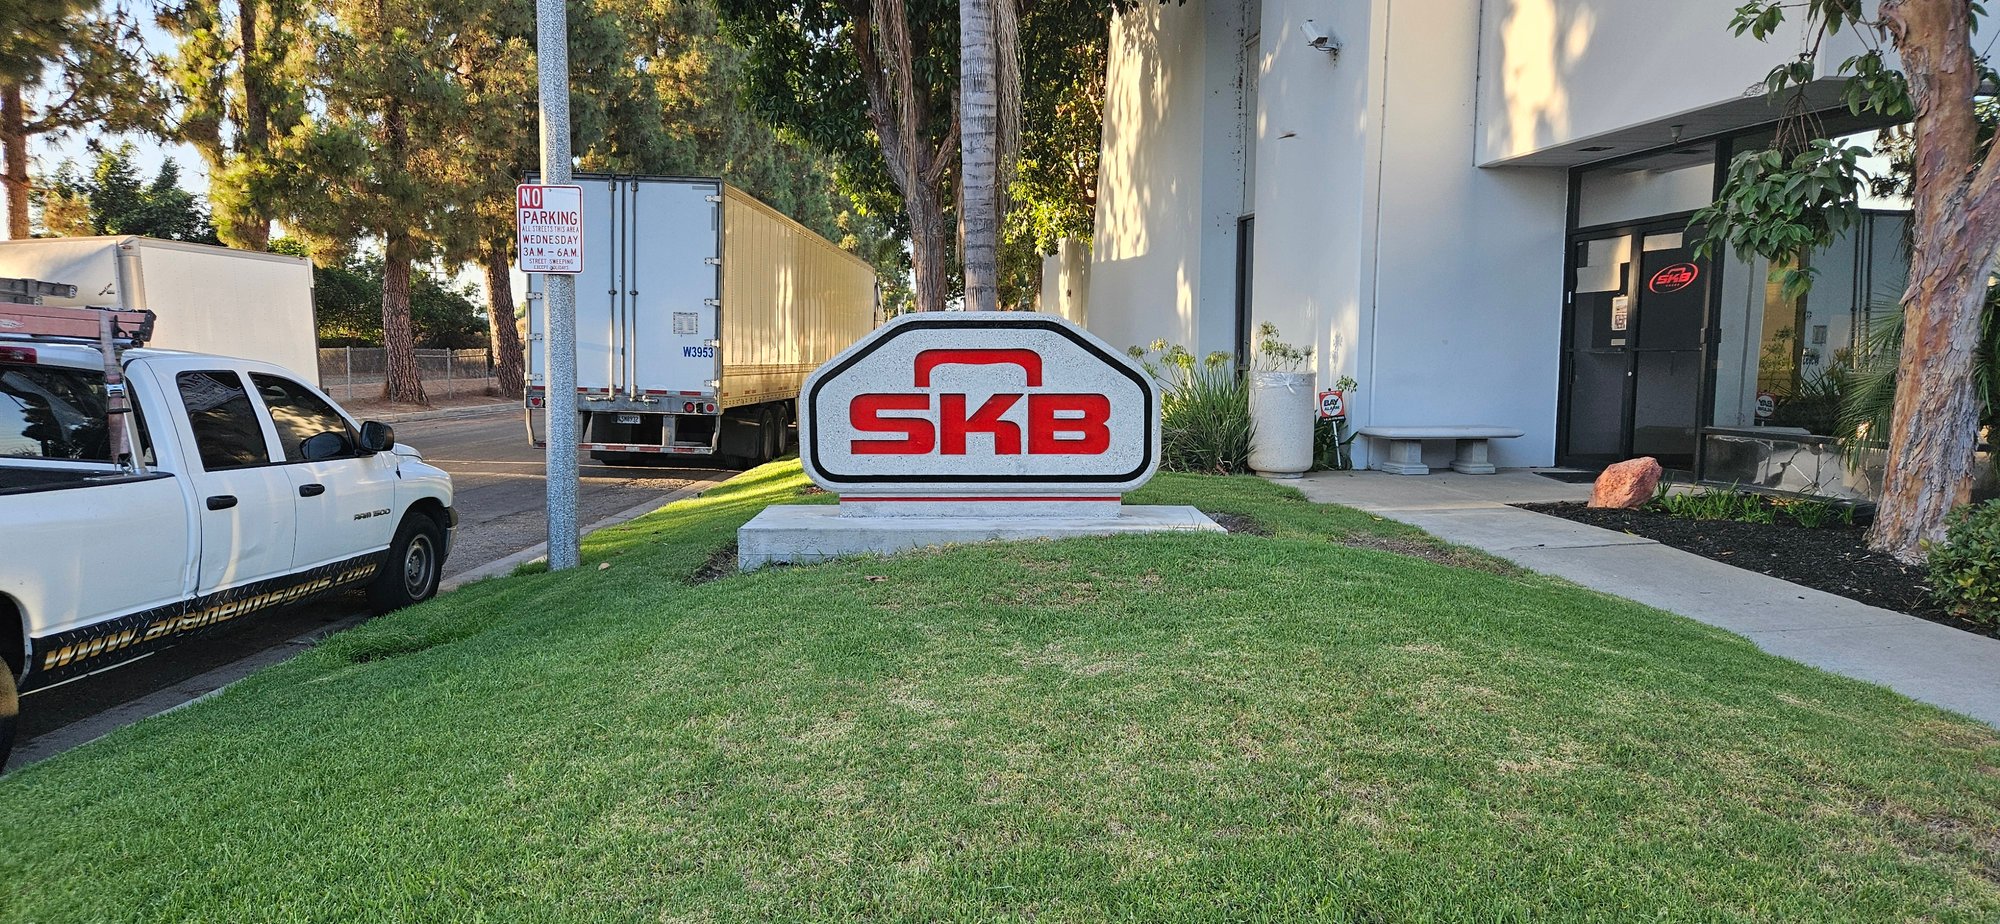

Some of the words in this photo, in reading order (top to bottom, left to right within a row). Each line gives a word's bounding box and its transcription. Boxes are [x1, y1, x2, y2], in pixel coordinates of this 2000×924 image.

[521, 188, 541, 207] NO
[523, 211, 578, 225] PARKING
[522, 234, 579, 245] WEDNESDAY
[1655, 272, 1692, 284] SKB
[682, 346, 714, 358] W3953
[1324, 398, 1339, 406] BAY
[849, 393, 1111, 455] SKB
[353, 511, 372, 521] RAM
[372, 508, 391, 518] 1500
